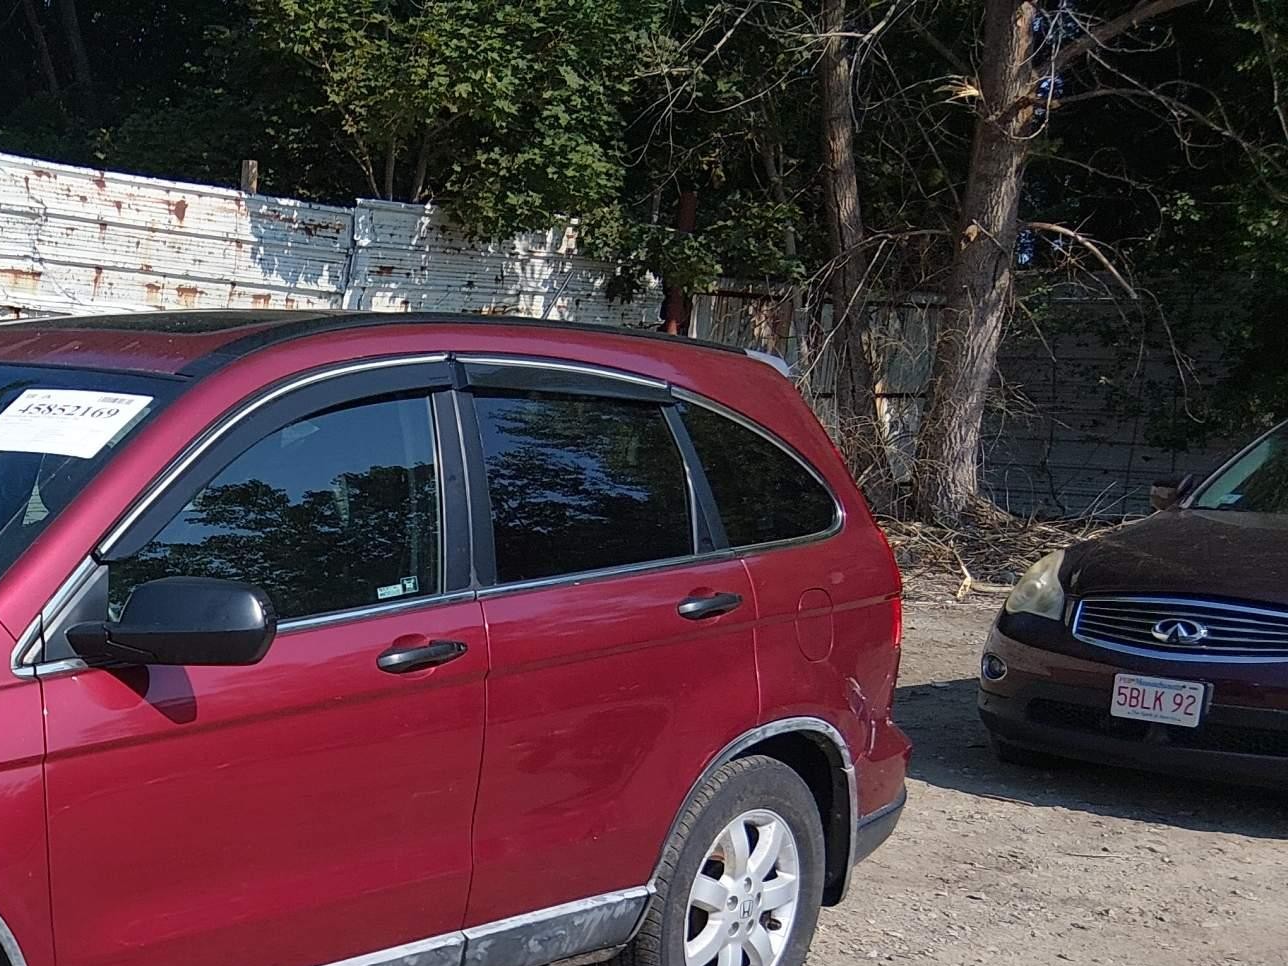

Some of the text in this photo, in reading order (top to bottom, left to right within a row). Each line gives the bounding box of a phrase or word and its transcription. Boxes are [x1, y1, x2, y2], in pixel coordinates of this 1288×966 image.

[18, 403, 120, 419] 45852169
[1116, 686, 1197, 716] 5BLK 92
